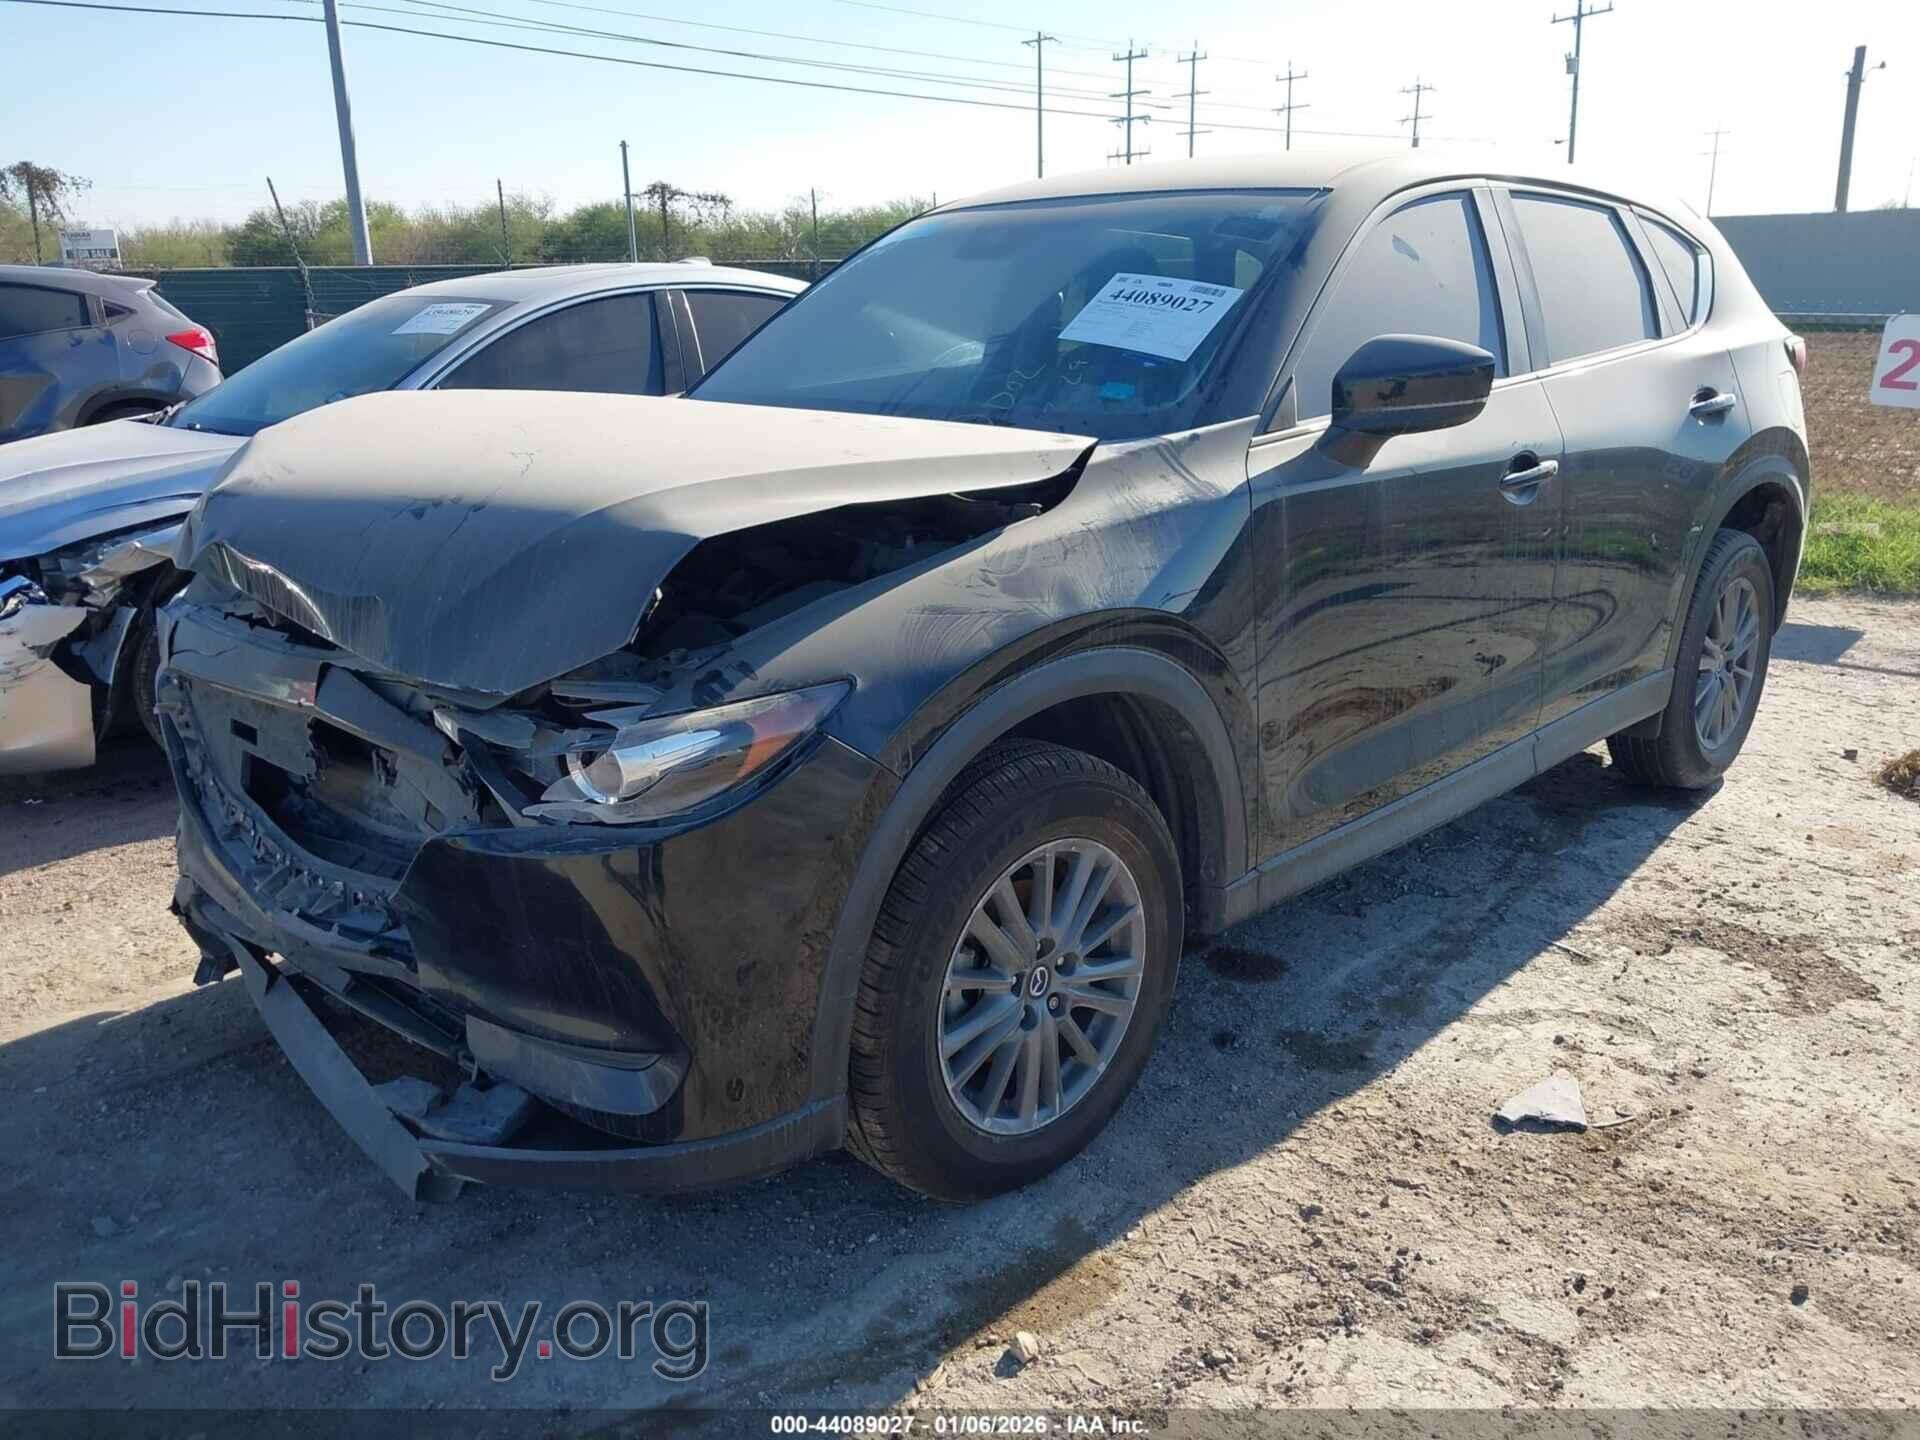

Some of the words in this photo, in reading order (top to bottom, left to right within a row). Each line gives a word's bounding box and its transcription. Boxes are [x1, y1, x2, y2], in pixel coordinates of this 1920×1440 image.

[92, 249, 112, 258] SALE
[1108, 287, 1215, 314] 44089027
[1879, 338, 1920, 391] 2
